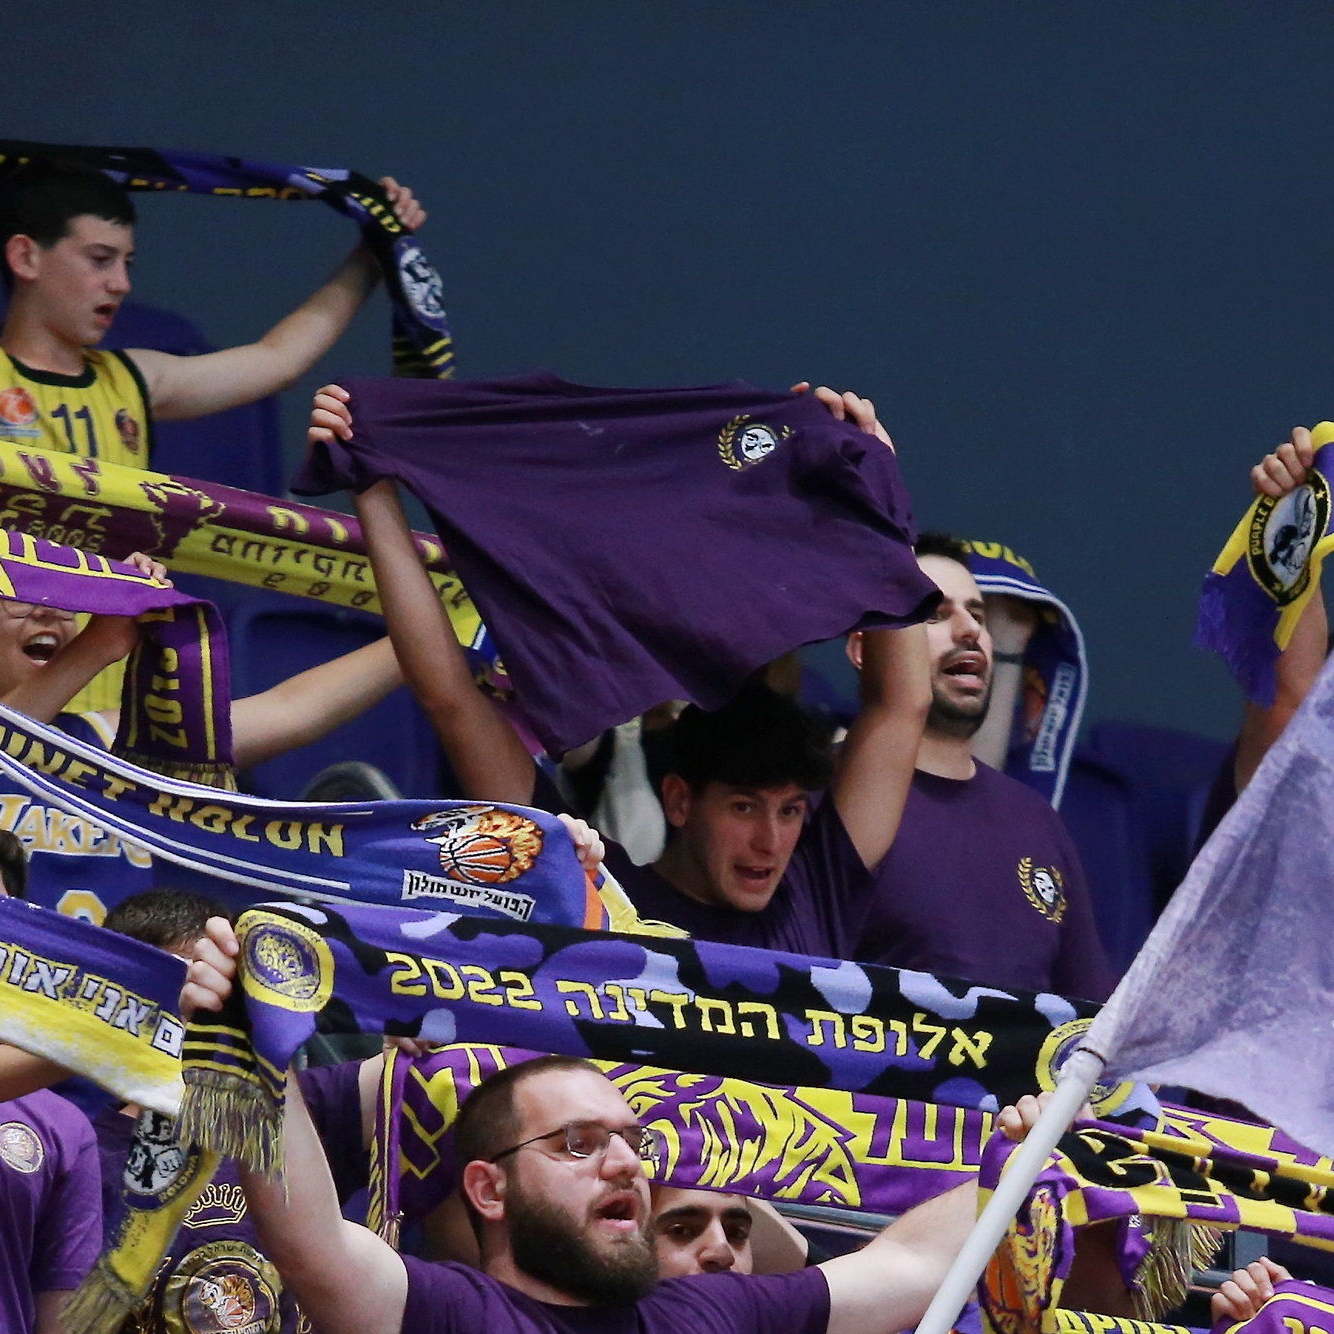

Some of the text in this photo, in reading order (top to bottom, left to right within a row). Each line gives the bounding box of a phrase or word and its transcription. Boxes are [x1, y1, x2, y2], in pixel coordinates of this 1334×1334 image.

[51, 403, 99, 458] 11
[81, 976, 152, 1037] אני
[385, 949, 994, 1074] אלופת המדינה 2022
